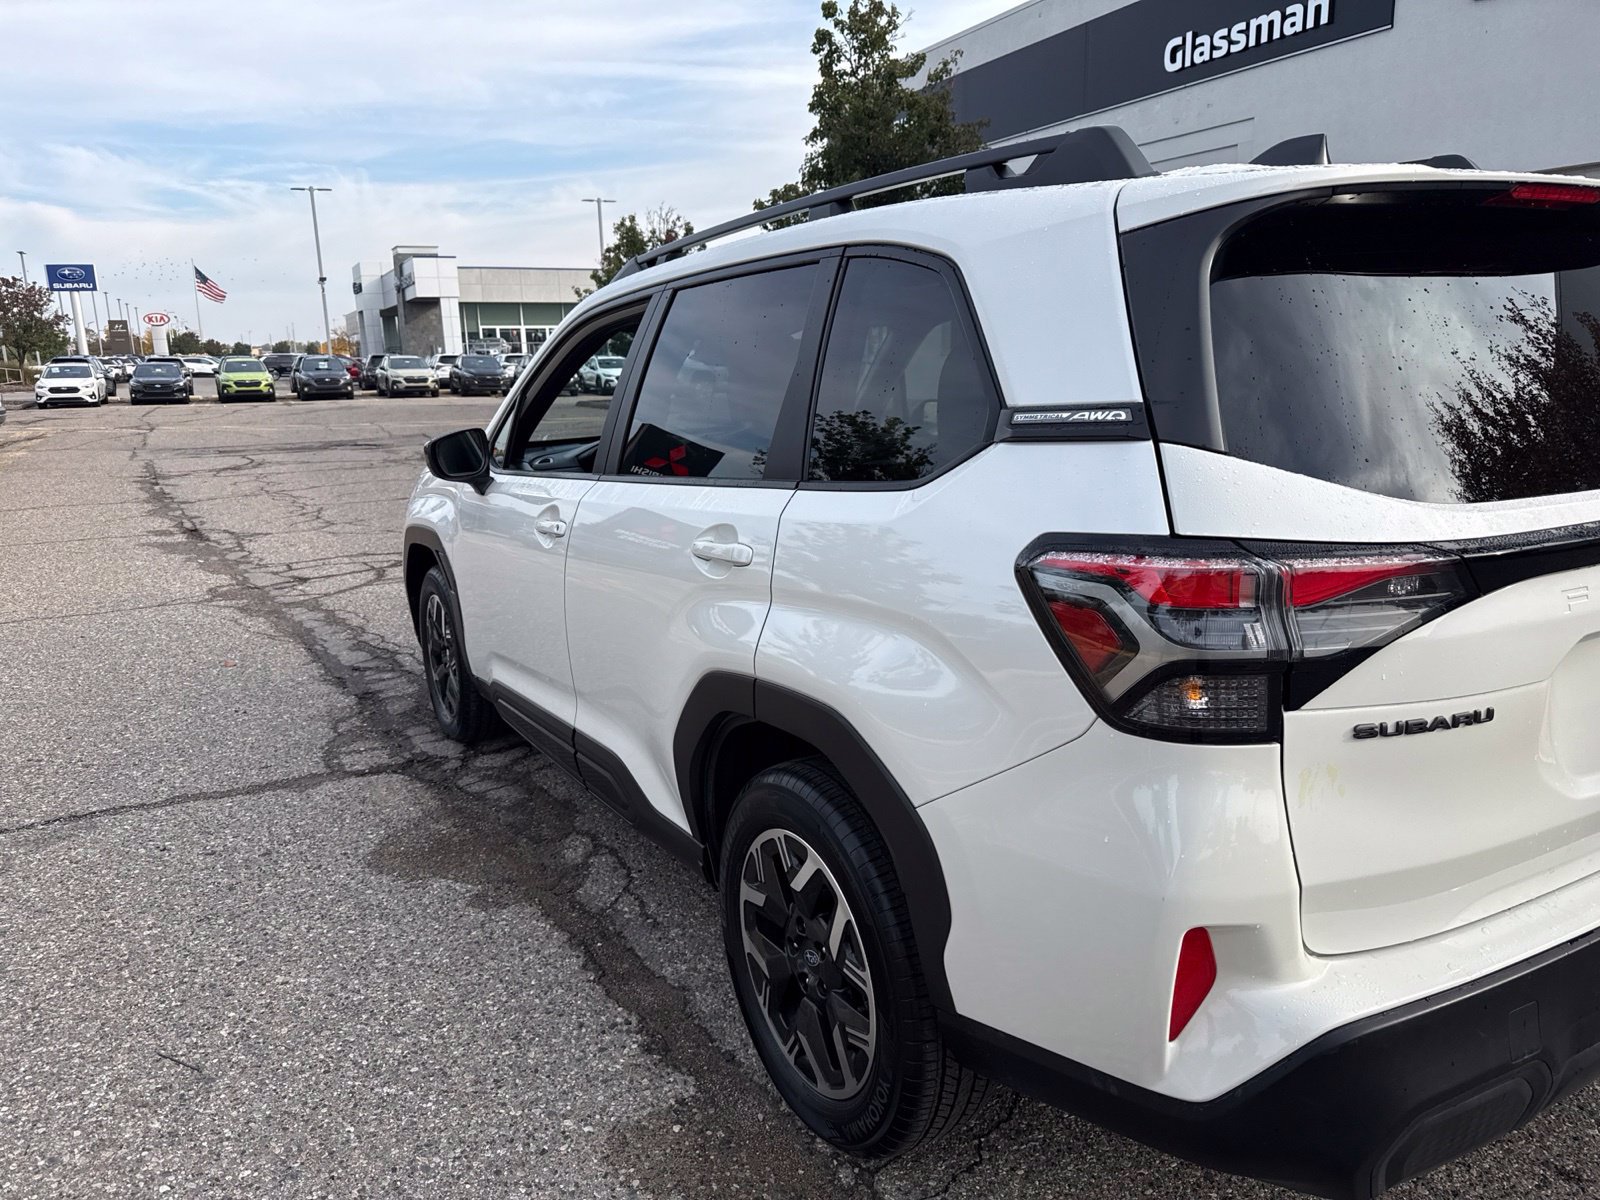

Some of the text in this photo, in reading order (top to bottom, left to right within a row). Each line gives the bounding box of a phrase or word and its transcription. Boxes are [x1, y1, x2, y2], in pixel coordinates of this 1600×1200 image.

[1163, 0, 1331, 73] Glassman
[52, 282, 93, 290] SUBARU
[147, 315, 166, 323] KIA
[1014, 410, 1127, 421] SYMMETRICAL AWD
[1353, 706, 1495, 739] SUBARU
